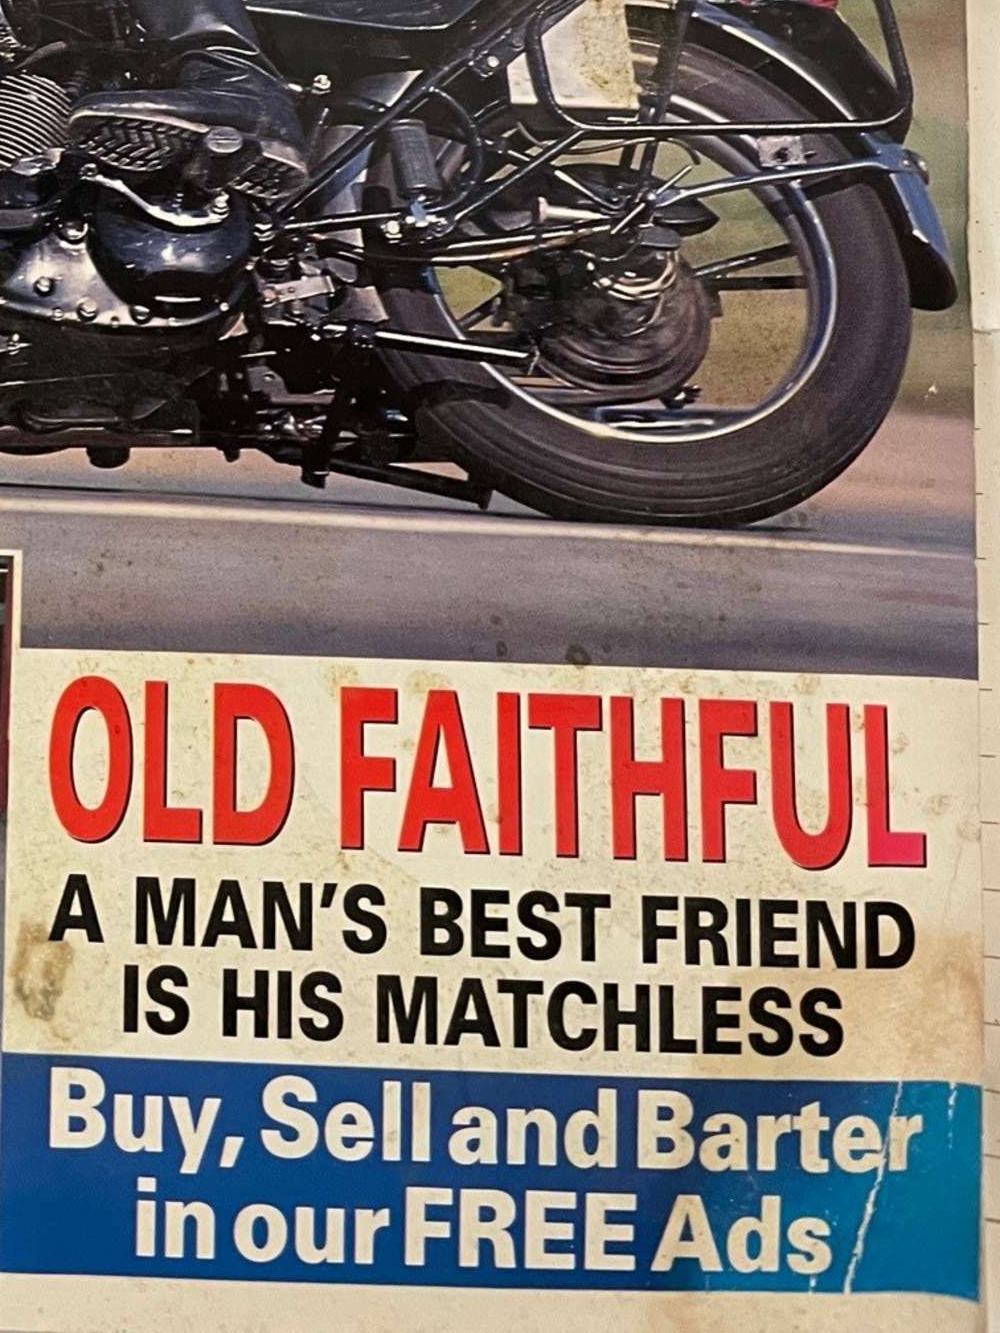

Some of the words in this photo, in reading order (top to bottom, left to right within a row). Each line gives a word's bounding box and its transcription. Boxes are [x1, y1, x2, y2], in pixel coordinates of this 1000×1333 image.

[47, 675, 297, 846] OLD
[340, 686, 929, 872] FAITHFUL
[48, 874, 106, 944] A
[134, 877, 388, 956] MAN'S
[420, 887, 612, 963] BEST
[640, 895, 917, 970] FRIEND
[123, 964, 192, 1037] IS
[221, 968, 346, 1041] HIS
[376, 974, 846, 1057] MATCHLESS
[47, 1066, 244, 1176] Buy,
[261, 1073, 431, 1163] Sell
[448, 1086, 619, 1171] and
[635, 1090, 925, 1175] Barter
[135, 1177, 217, 1261] in
[234, 1200, 391, 1267] our
[404, 1187, 638, 1271] FREE
[651, 1193, 834, 1275] Ads
